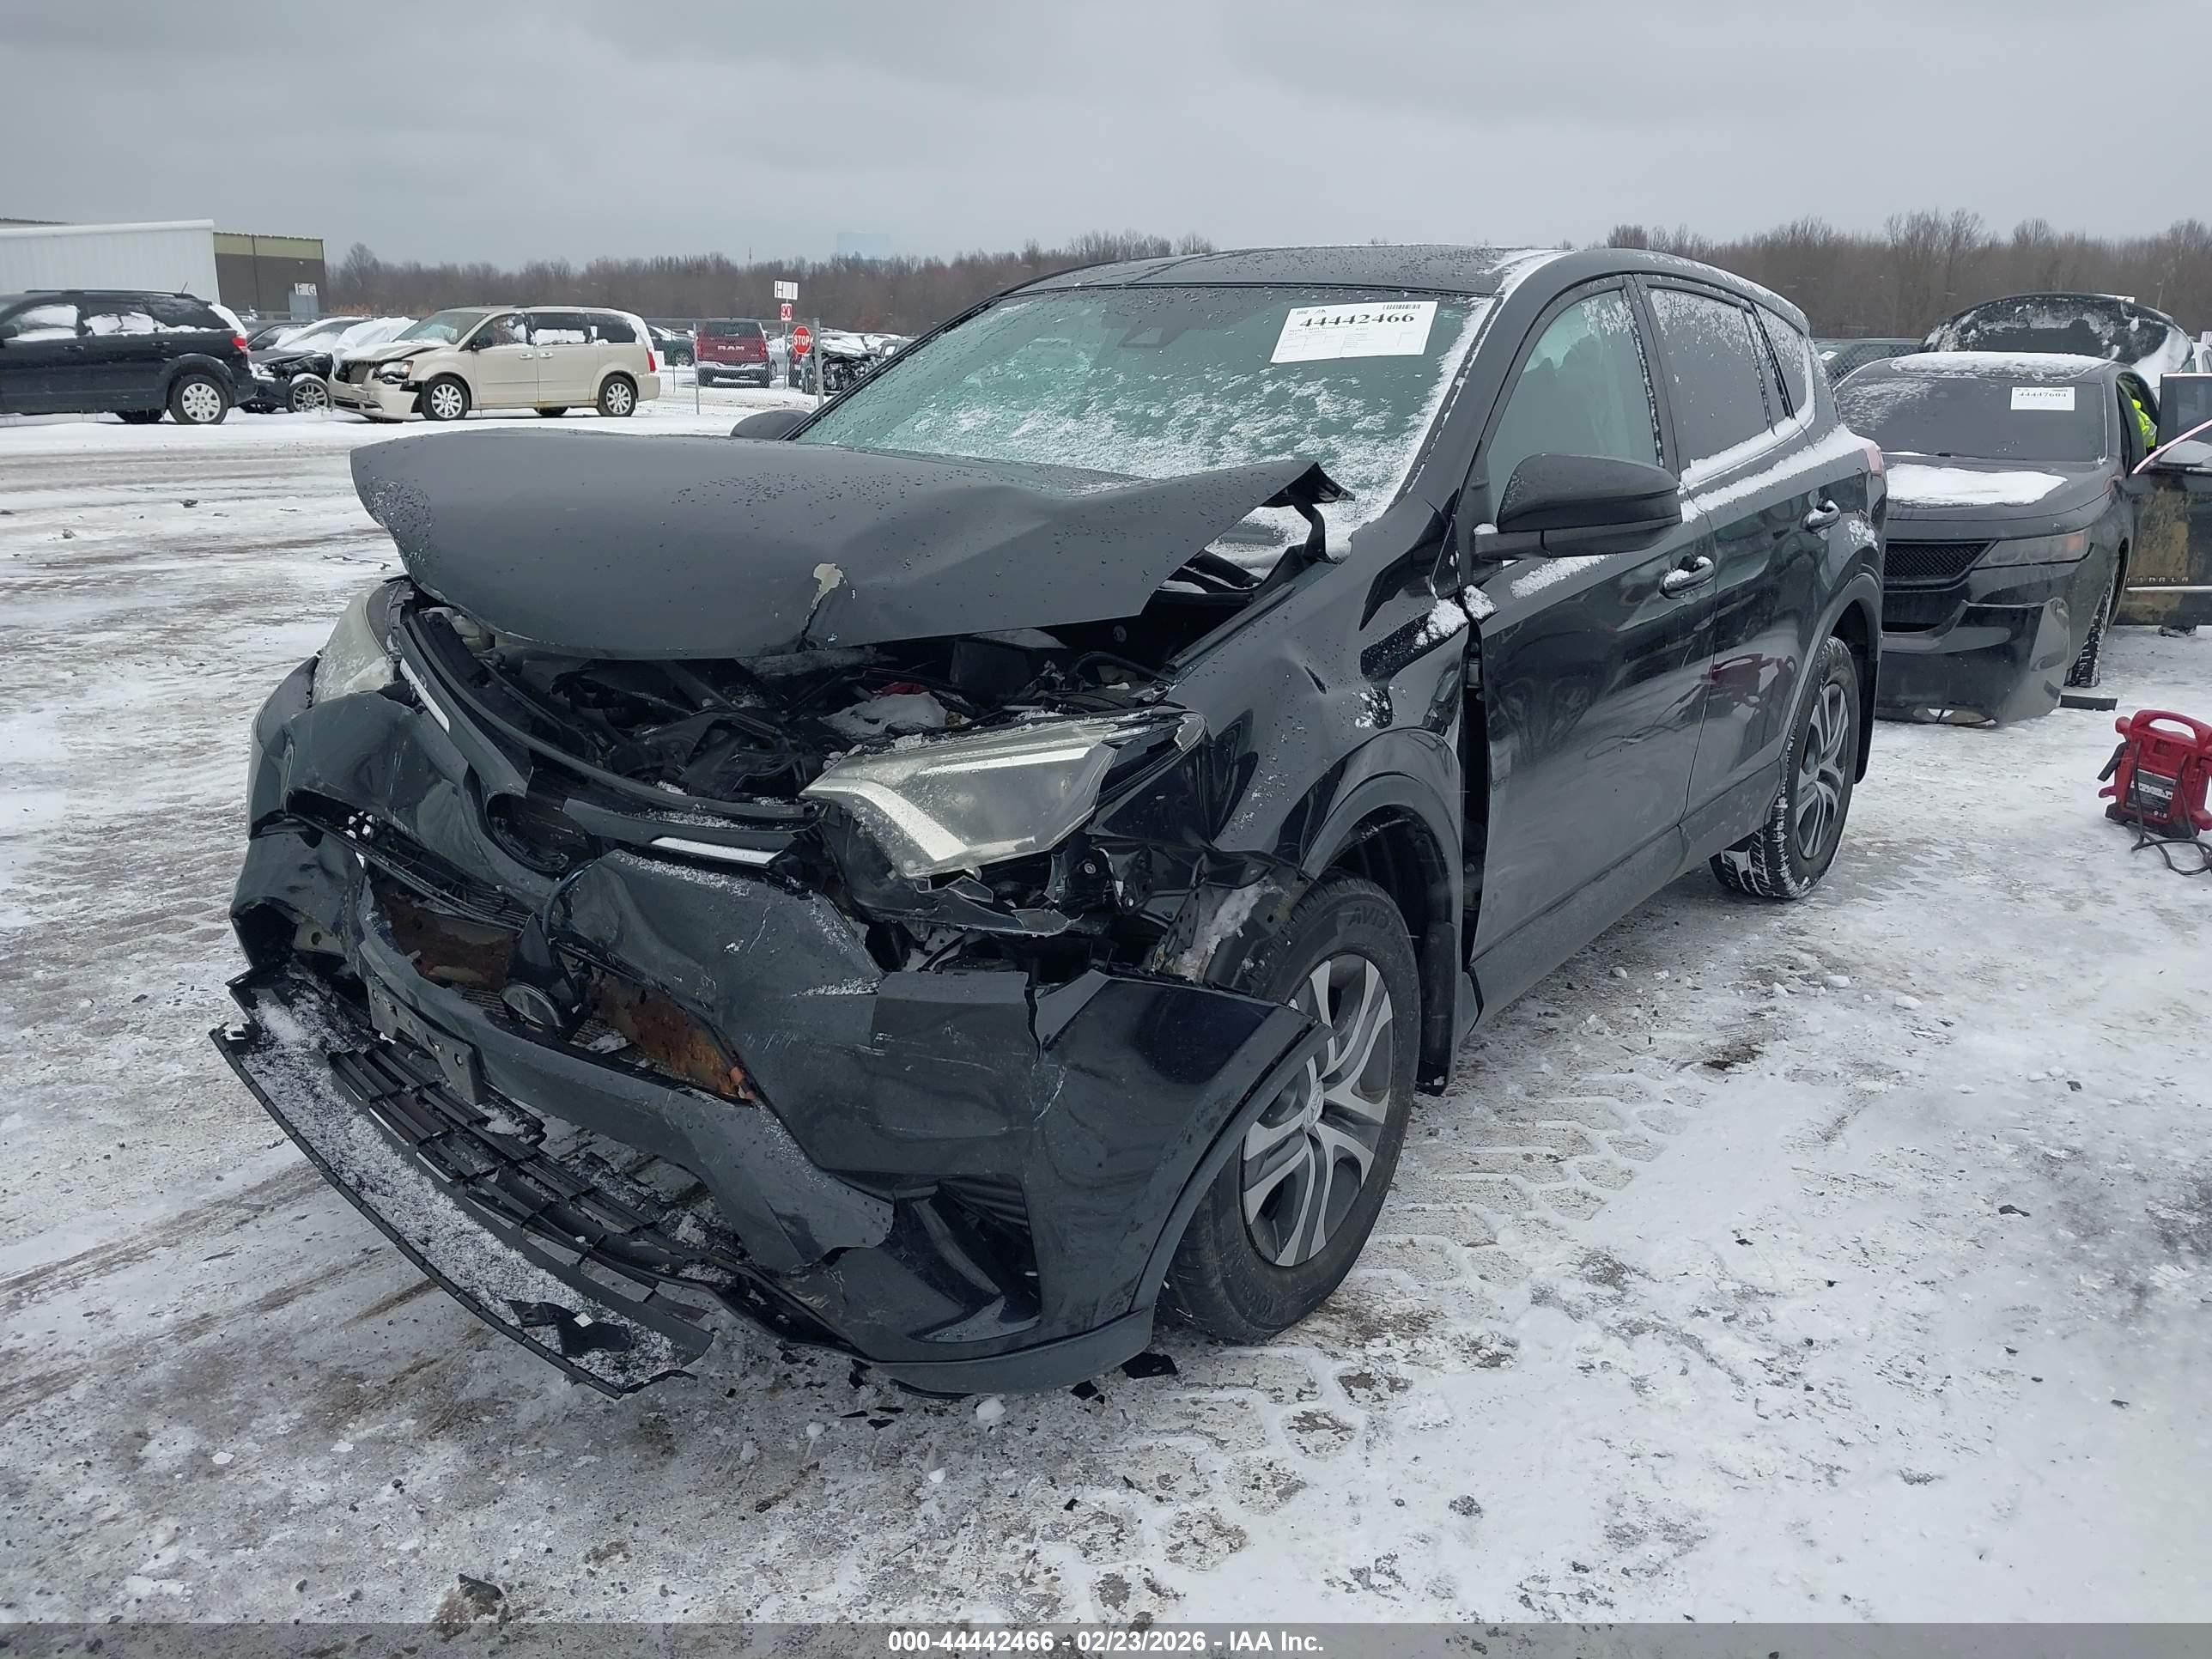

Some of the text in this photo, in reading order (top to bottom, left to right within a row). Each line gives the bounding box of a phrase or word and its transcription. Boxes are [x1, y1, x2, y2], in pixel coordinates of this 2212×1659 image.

[297, 283, 315, 295] F G
[775, 281, 784, 297] H
[781, 306, 792, 319] 90
[1299, 313, 1415, 327] 44442466
[793, 334, 810, 347] STOP
